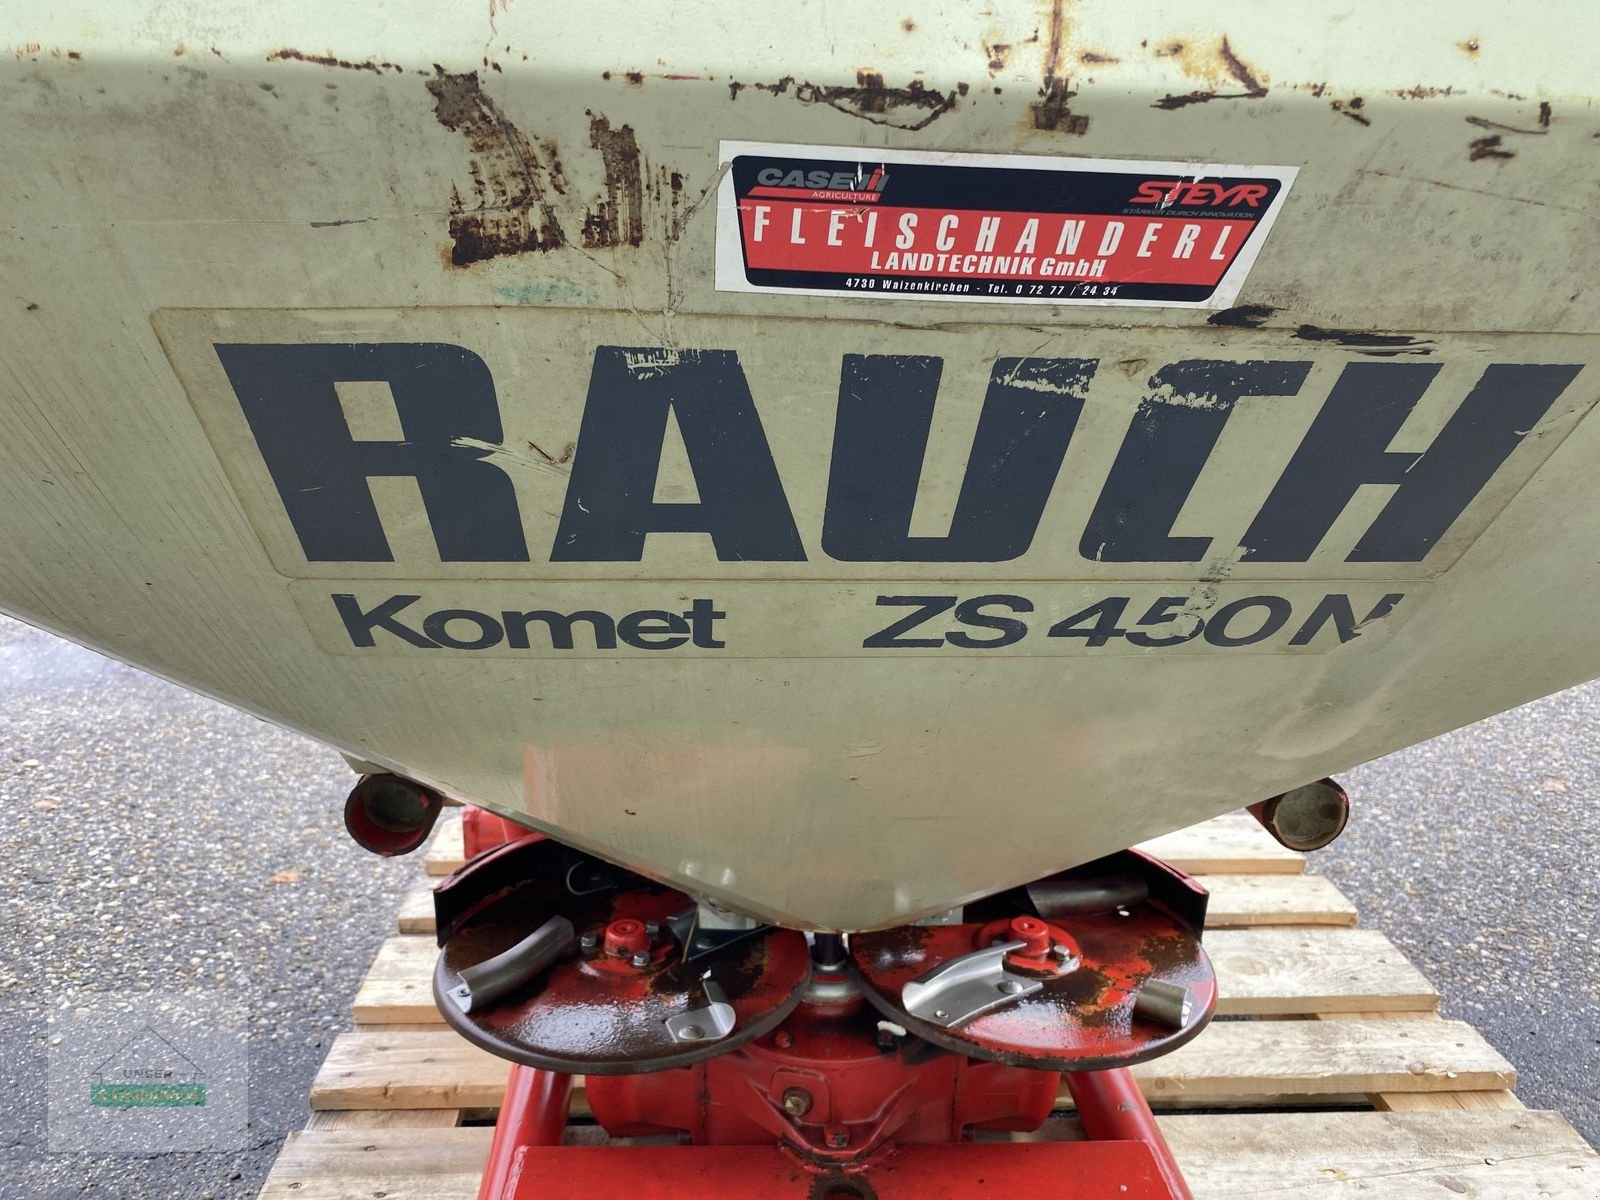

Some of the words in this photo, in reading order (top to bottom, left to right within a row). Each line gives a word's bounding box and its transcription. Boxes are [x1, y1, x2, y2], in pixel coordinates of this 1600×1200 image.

[811, 191, 877, 201] AGRICULTURE
[1128, 181, 1268, 207] STEYR
[753, 206, 1232, 260] FLEISCHANDERL
[870, 251, 1037, 275] LANDTECHNIK
[1040, 258, 1107, 278] GmbH
[846, 278, 876, 289] 4730
[882, 280, 970, 293] Waizenkirchen
[988, 283, 1008, 294] Tel.
[1016, 285, 1023, 294] 0
[1029, 285, 1044, 294] 72
[1050, 285, 1065, 295] 77
[1082, 285, 1097, 296] 24
[1103, 286, 1118, 296] 34
[213, 342, 1586, 562] RAUCH
[331, 593, 726, 649] Komet
[862, 594, 1034, 649] ZS
